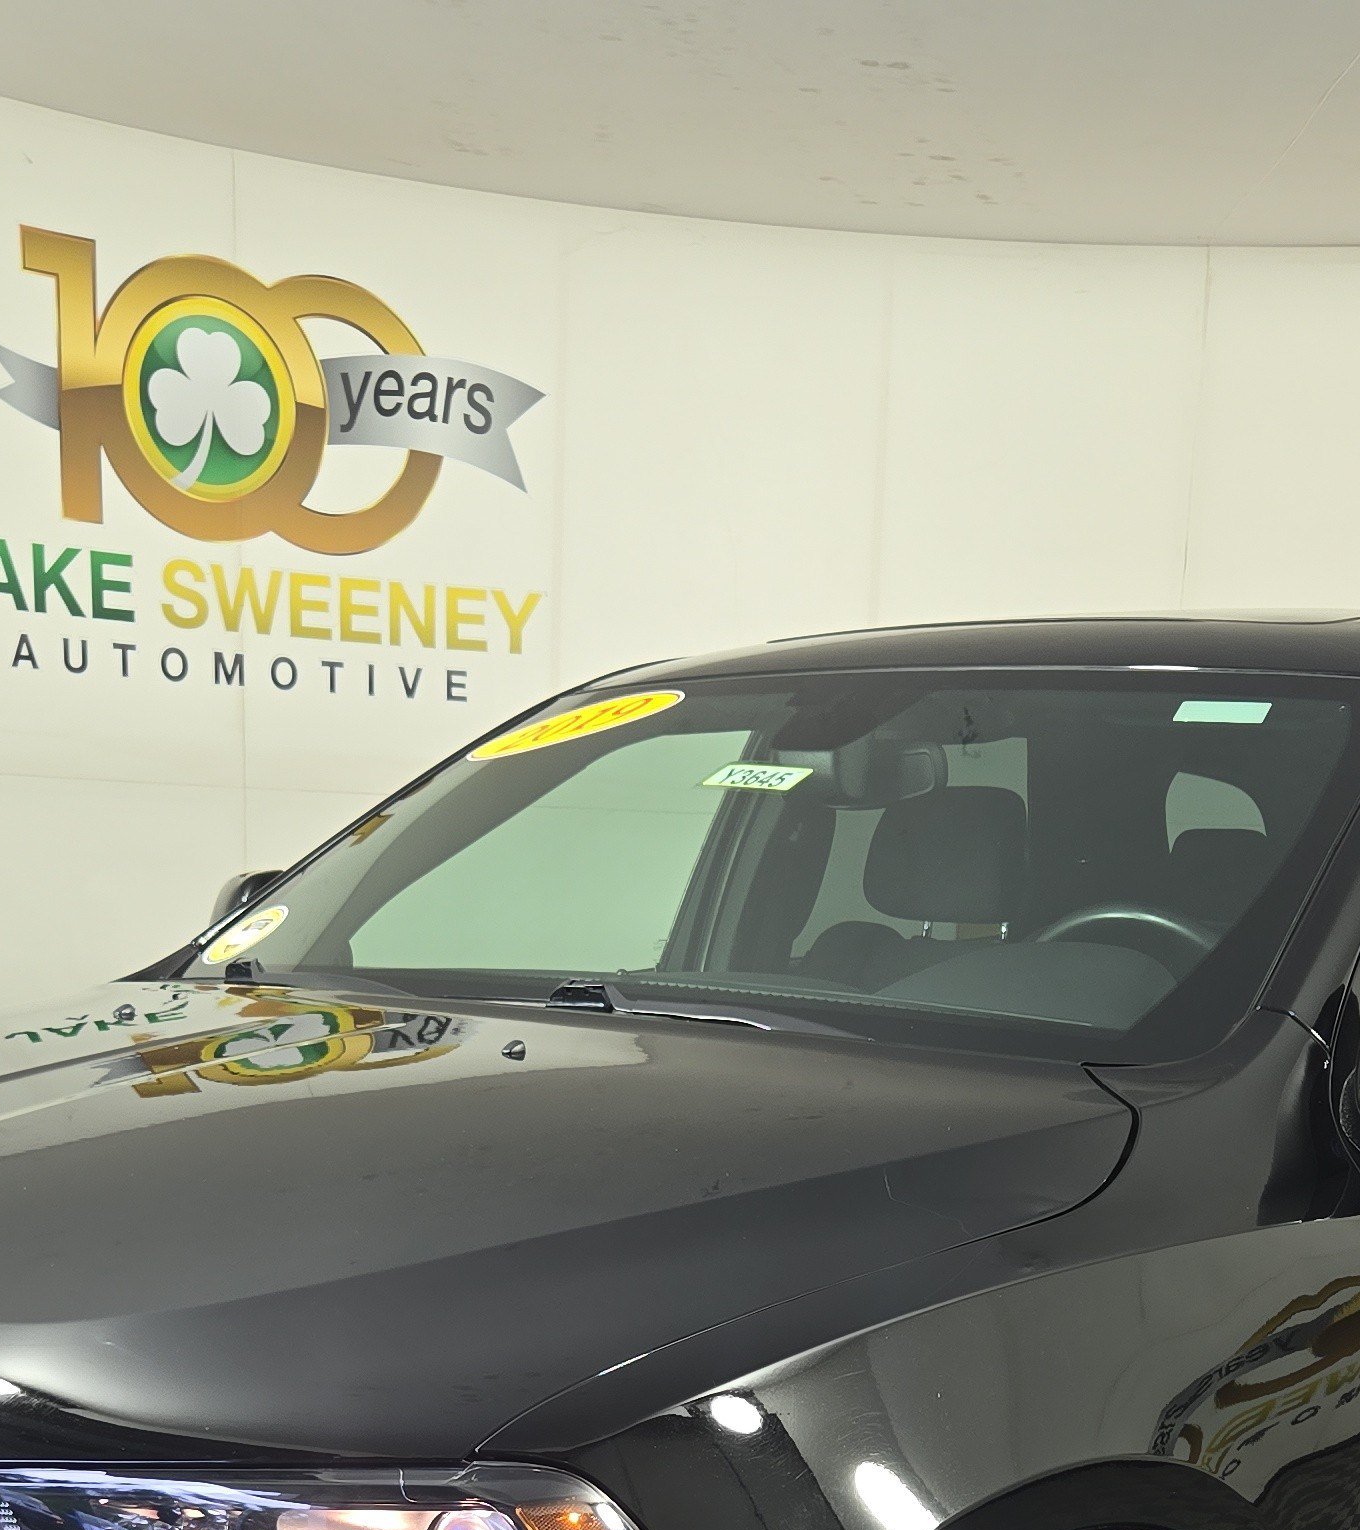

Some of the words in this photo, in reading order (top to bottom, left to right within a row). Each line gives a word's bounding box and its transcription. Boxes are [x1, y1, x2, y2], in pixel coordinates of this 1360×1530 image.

[18, 223, 443, 556] 100
[339, 368, 496, 435] years
[161, 559, 543, 655] SWEENEY
[10, 633, 469, 703] AUTOMOTIVE
[495, 697, 654, 753] 2019
[719, 768, 793, 788] Y3645
